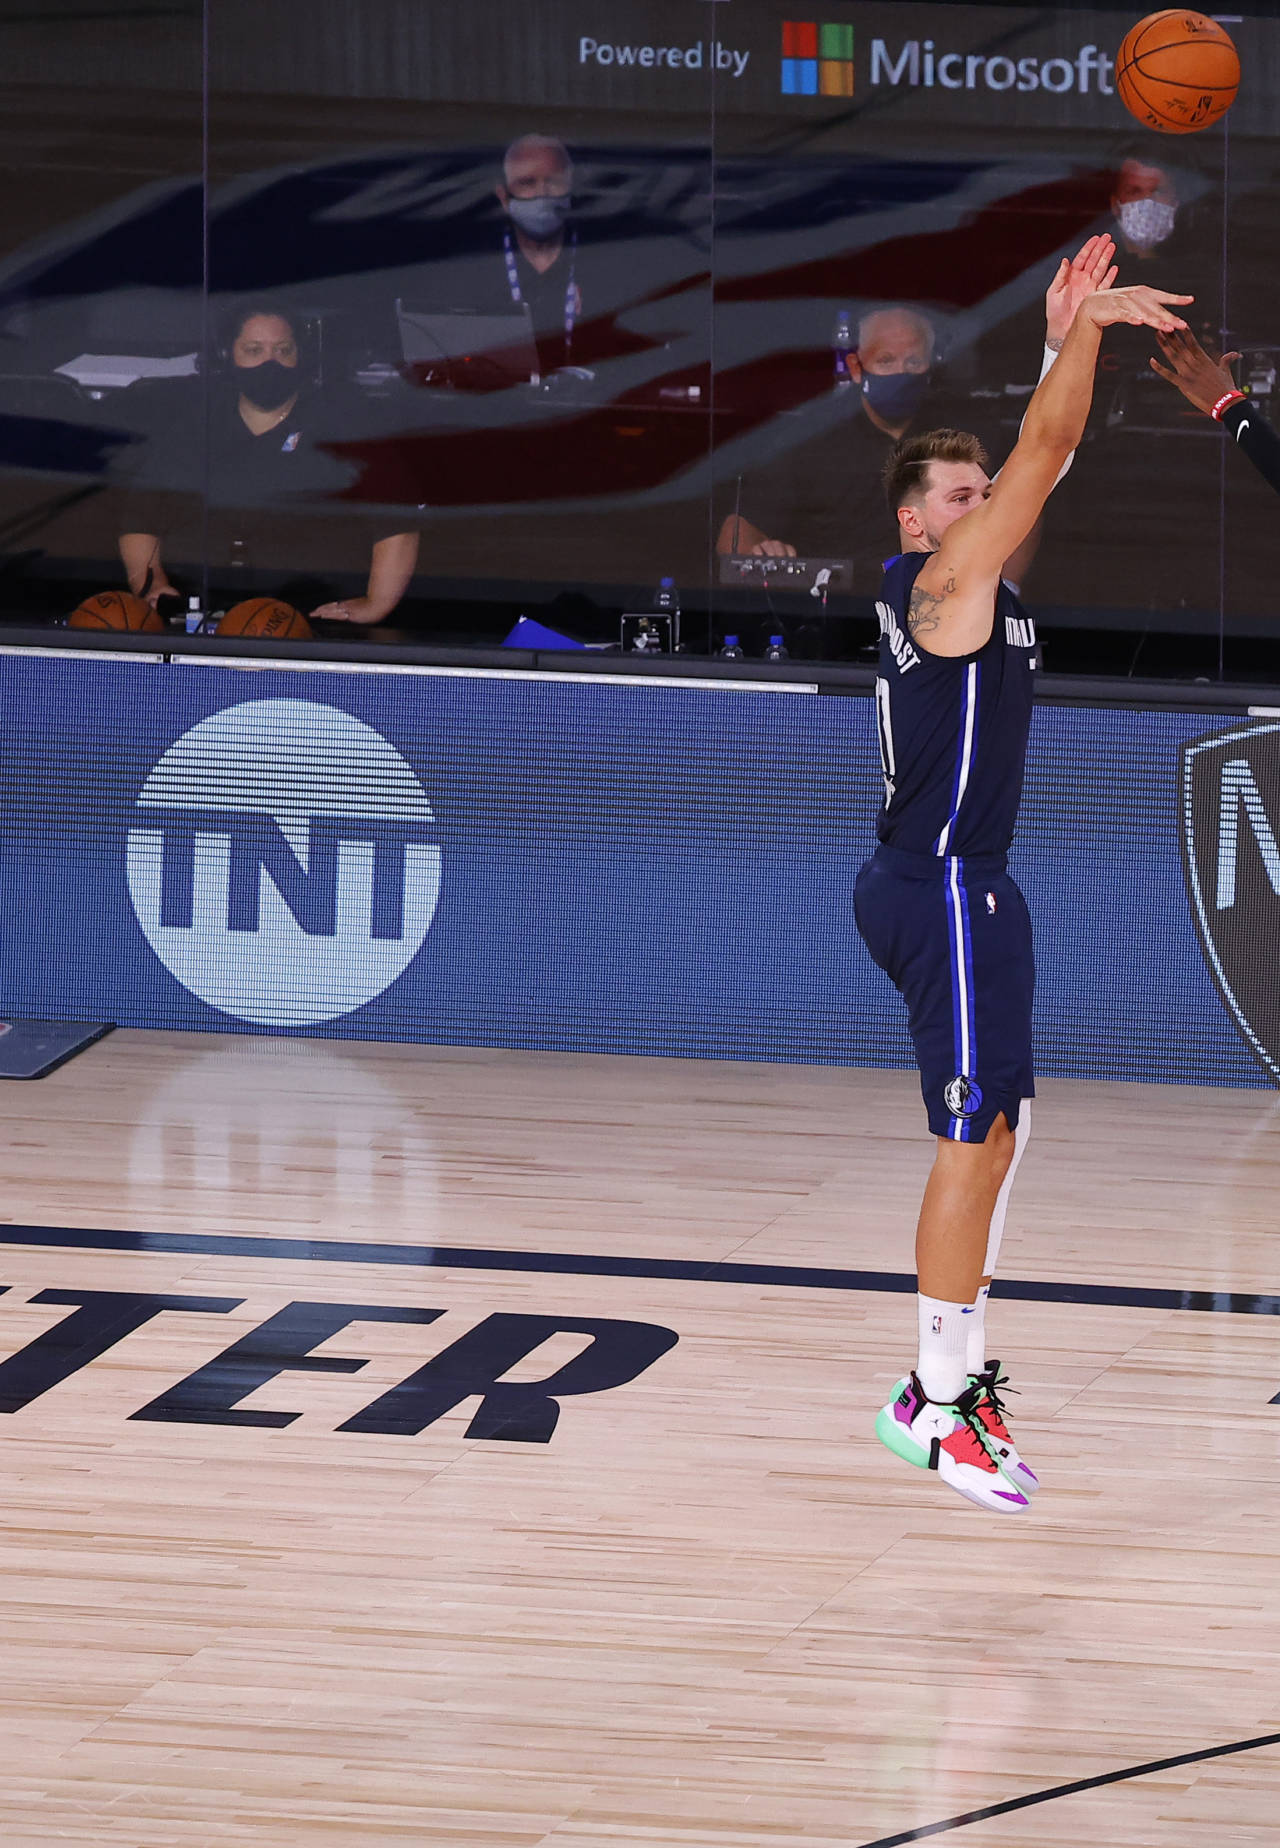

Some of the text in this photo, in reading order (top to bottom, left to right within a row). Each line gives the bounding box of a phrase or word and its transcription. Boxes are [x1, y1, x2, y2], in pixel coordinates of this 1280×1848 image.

[579, 37, 749, 77] Powered by
[870, 38, 1114, 94] Microsoft
[128, 805, 440, 940] TNT
[0, 1285, 680, 1444] TER
